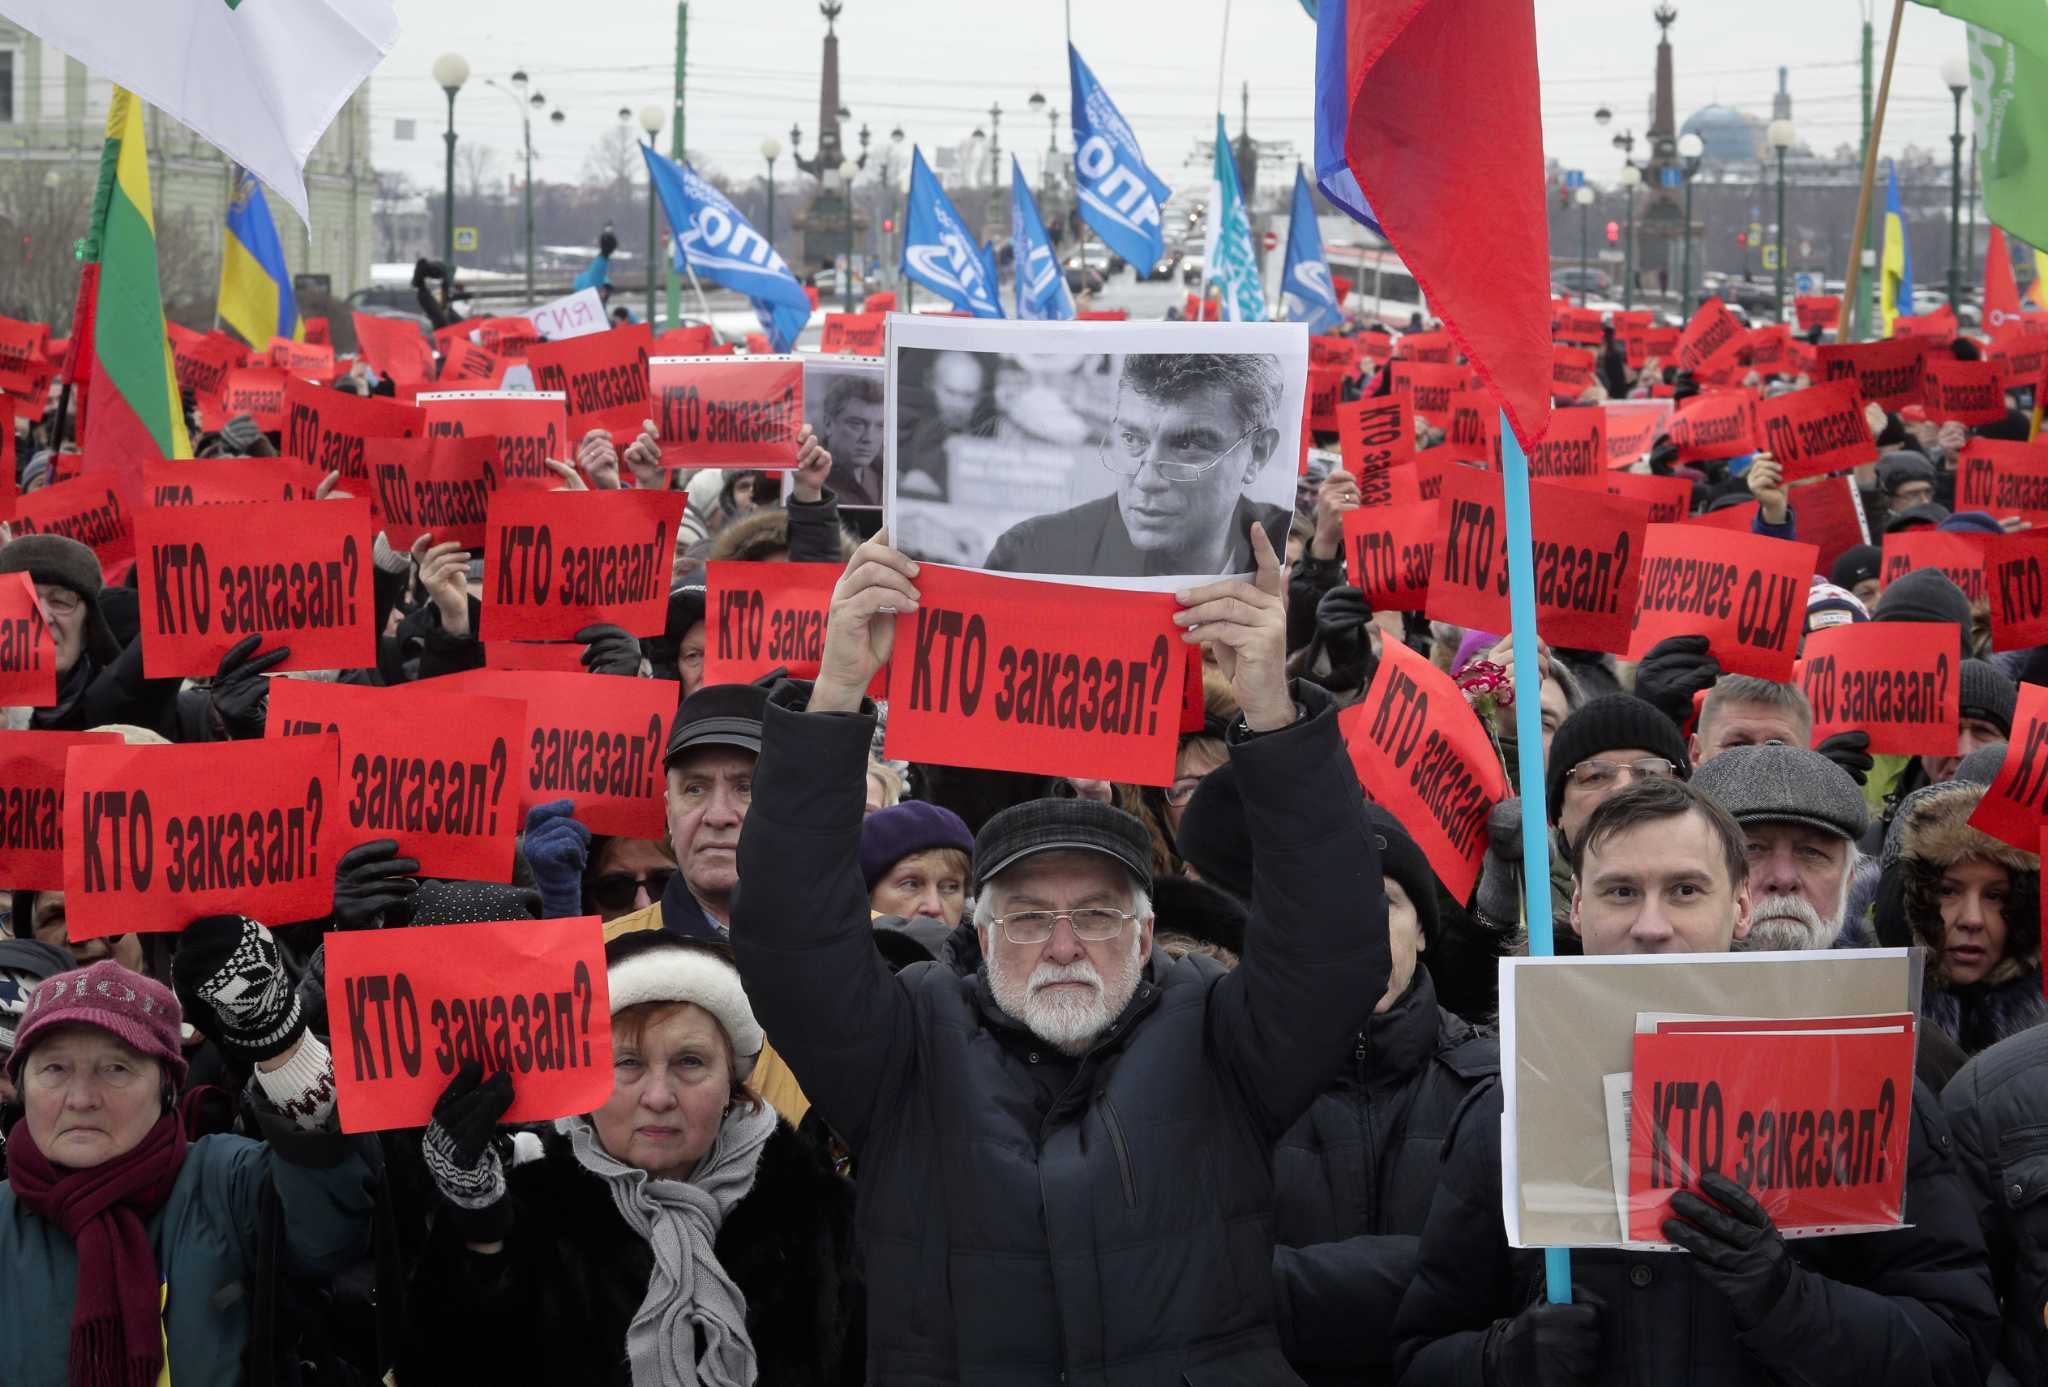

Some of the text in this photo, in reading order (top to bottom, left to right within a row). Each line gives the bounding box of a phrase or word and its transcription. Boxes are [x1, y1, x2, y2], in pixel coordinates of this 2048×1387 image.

[572, 346, 650, 414] заказал?
[662, 384, 794, 444] КТО заказал?
[290, 402, 369, 479] КТО зака
[1360, 403, 1401, 507] КТО заказ
[1963, 457, 1994, 508] КТО
[376, 460, 497, 528] КТО заказал?
[152, 534, 358, 636] КТО заказал?
[496, 520, 667, 608] КТО заказал?
[1356, 530, 1397, 596] КТО
[1443, 498, 1497, 592] КТО
[718, 589, 826, 662] КТО зака
[1737, 569, 1797, 653] КТО
[1998, 555, 2043, 625] КТО
[909, 606, 1170, 737] КТО заказал?
[1840, 652, 1948, 725] заказал?
[529, 713, 663, 800] заказал?
[1370, 663, 1429, 768] КТО
[349, 736, 508, 837] заказал?
[83, 776, 324, 894] КТО заказал?
[345, 959, 593, 1082] КТО заказал?
[1651, 1077, 1896, 1190] КТО заказал?
